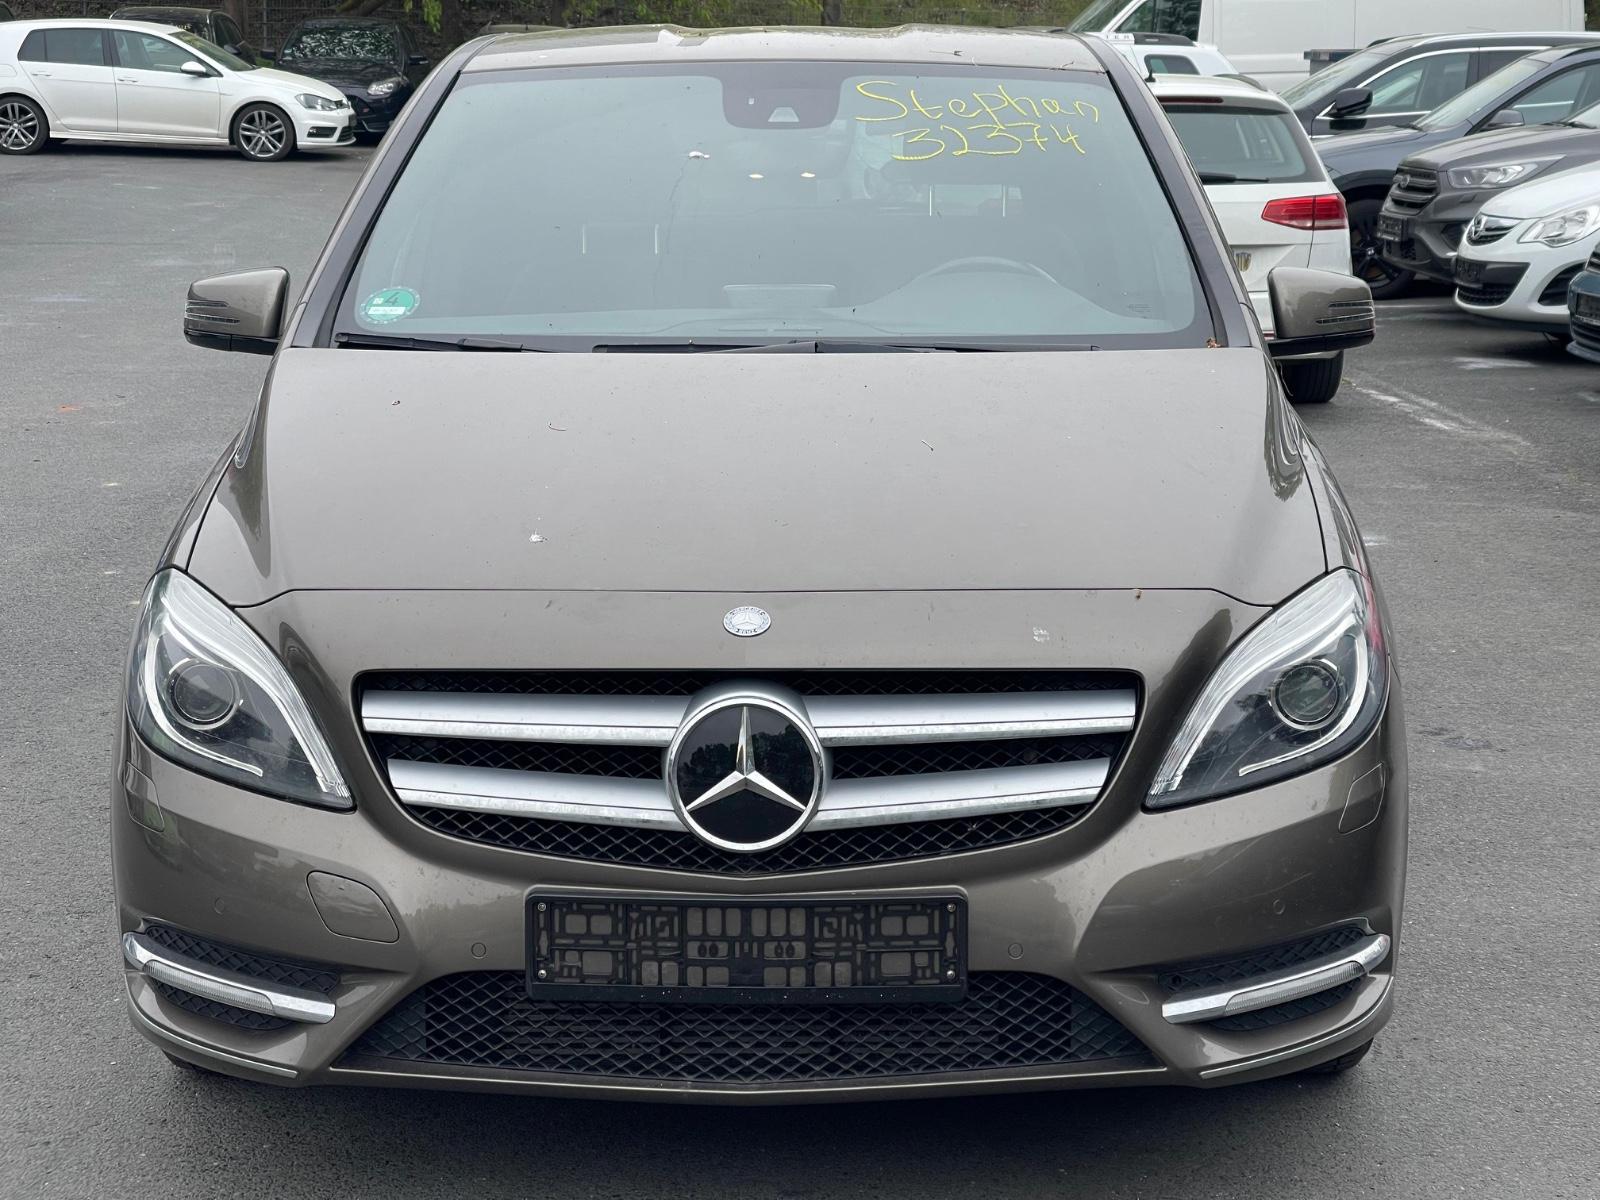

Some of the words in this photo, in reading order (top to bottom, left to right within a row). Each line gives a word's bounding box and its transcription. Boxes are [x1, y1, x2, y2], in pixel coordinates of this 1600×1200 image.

[856, 80, 1099, 129] Stephan
[892, 122, 1086, 161] 32374
[384, 291, 400, 306] 4
